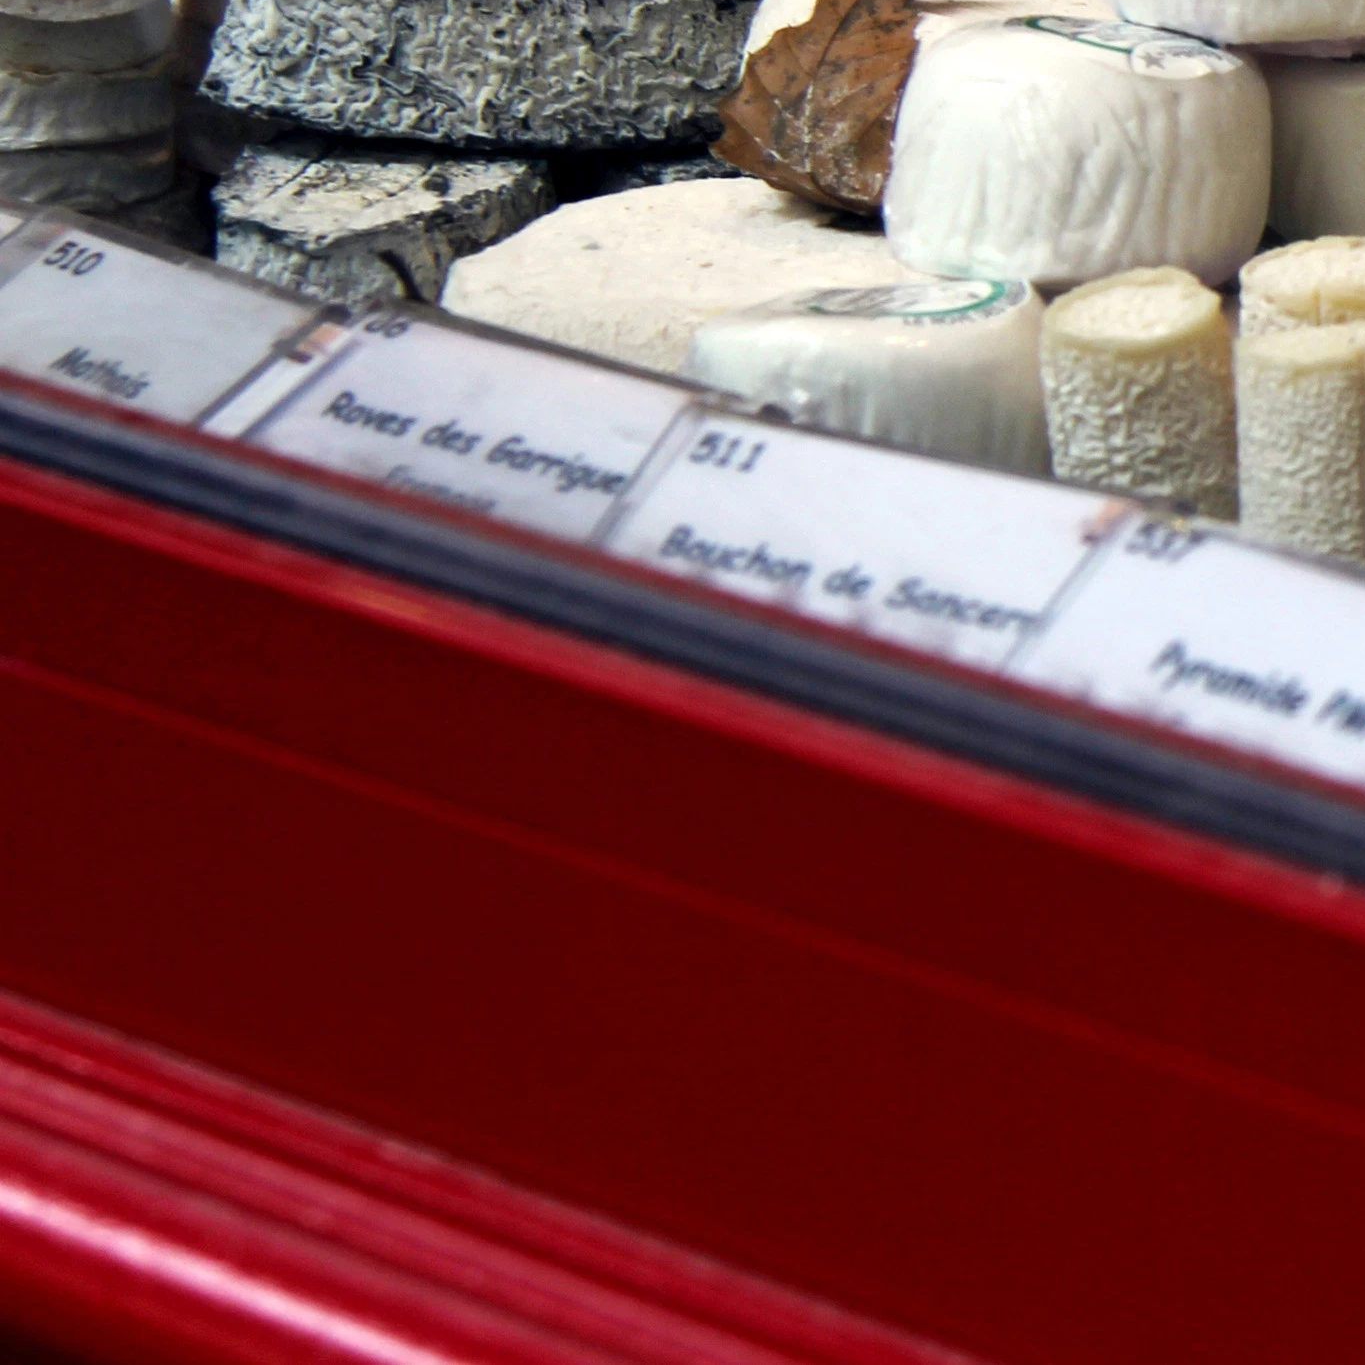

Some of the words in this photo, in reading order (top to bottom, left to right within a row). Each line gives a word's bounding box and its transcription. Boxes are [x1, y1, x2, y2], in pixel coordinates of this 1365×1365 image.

[43, 240, 106, 277] 510
[321, 390, 418, 437] Roves
[420, 418, 481, 456] des
[688, 430, 766, 473] 511
[659, 522, 814, 584] Bouchon
[821, 560, 875, 602] de
[1147, 635, 1311, 719] Pyramide
